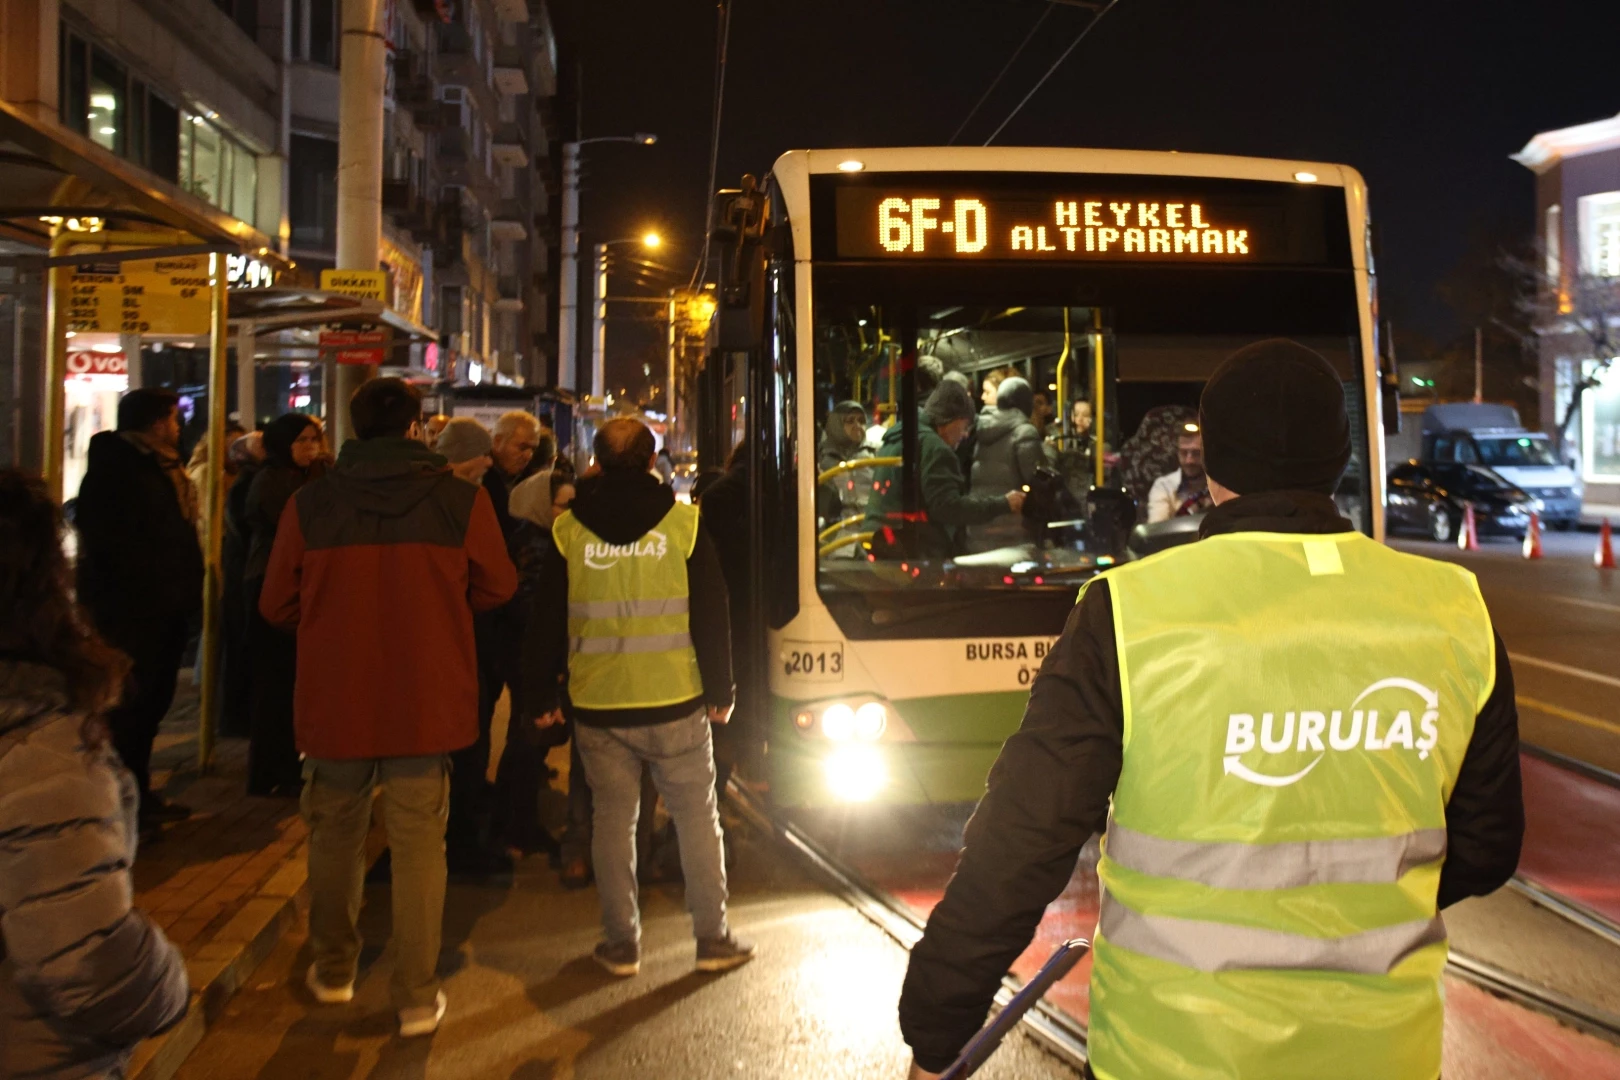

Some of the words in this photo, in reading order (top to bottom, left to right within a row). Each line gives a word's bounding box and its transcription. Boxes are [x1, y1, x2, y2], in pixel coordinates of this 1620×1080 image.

[879, 198, 987, 252] 6F-D
[1055, 202, 1210, 228] HEYKEL
[1011, 226, 1249, 253] ALTIPARMAK
[584, 541, 668, 561] BURULAŞ
[791, 651, 842, 674] 2013
[966, 642, 1028, 660] BURSA
[1225, 709, 1439, 761] BURULAŞ
